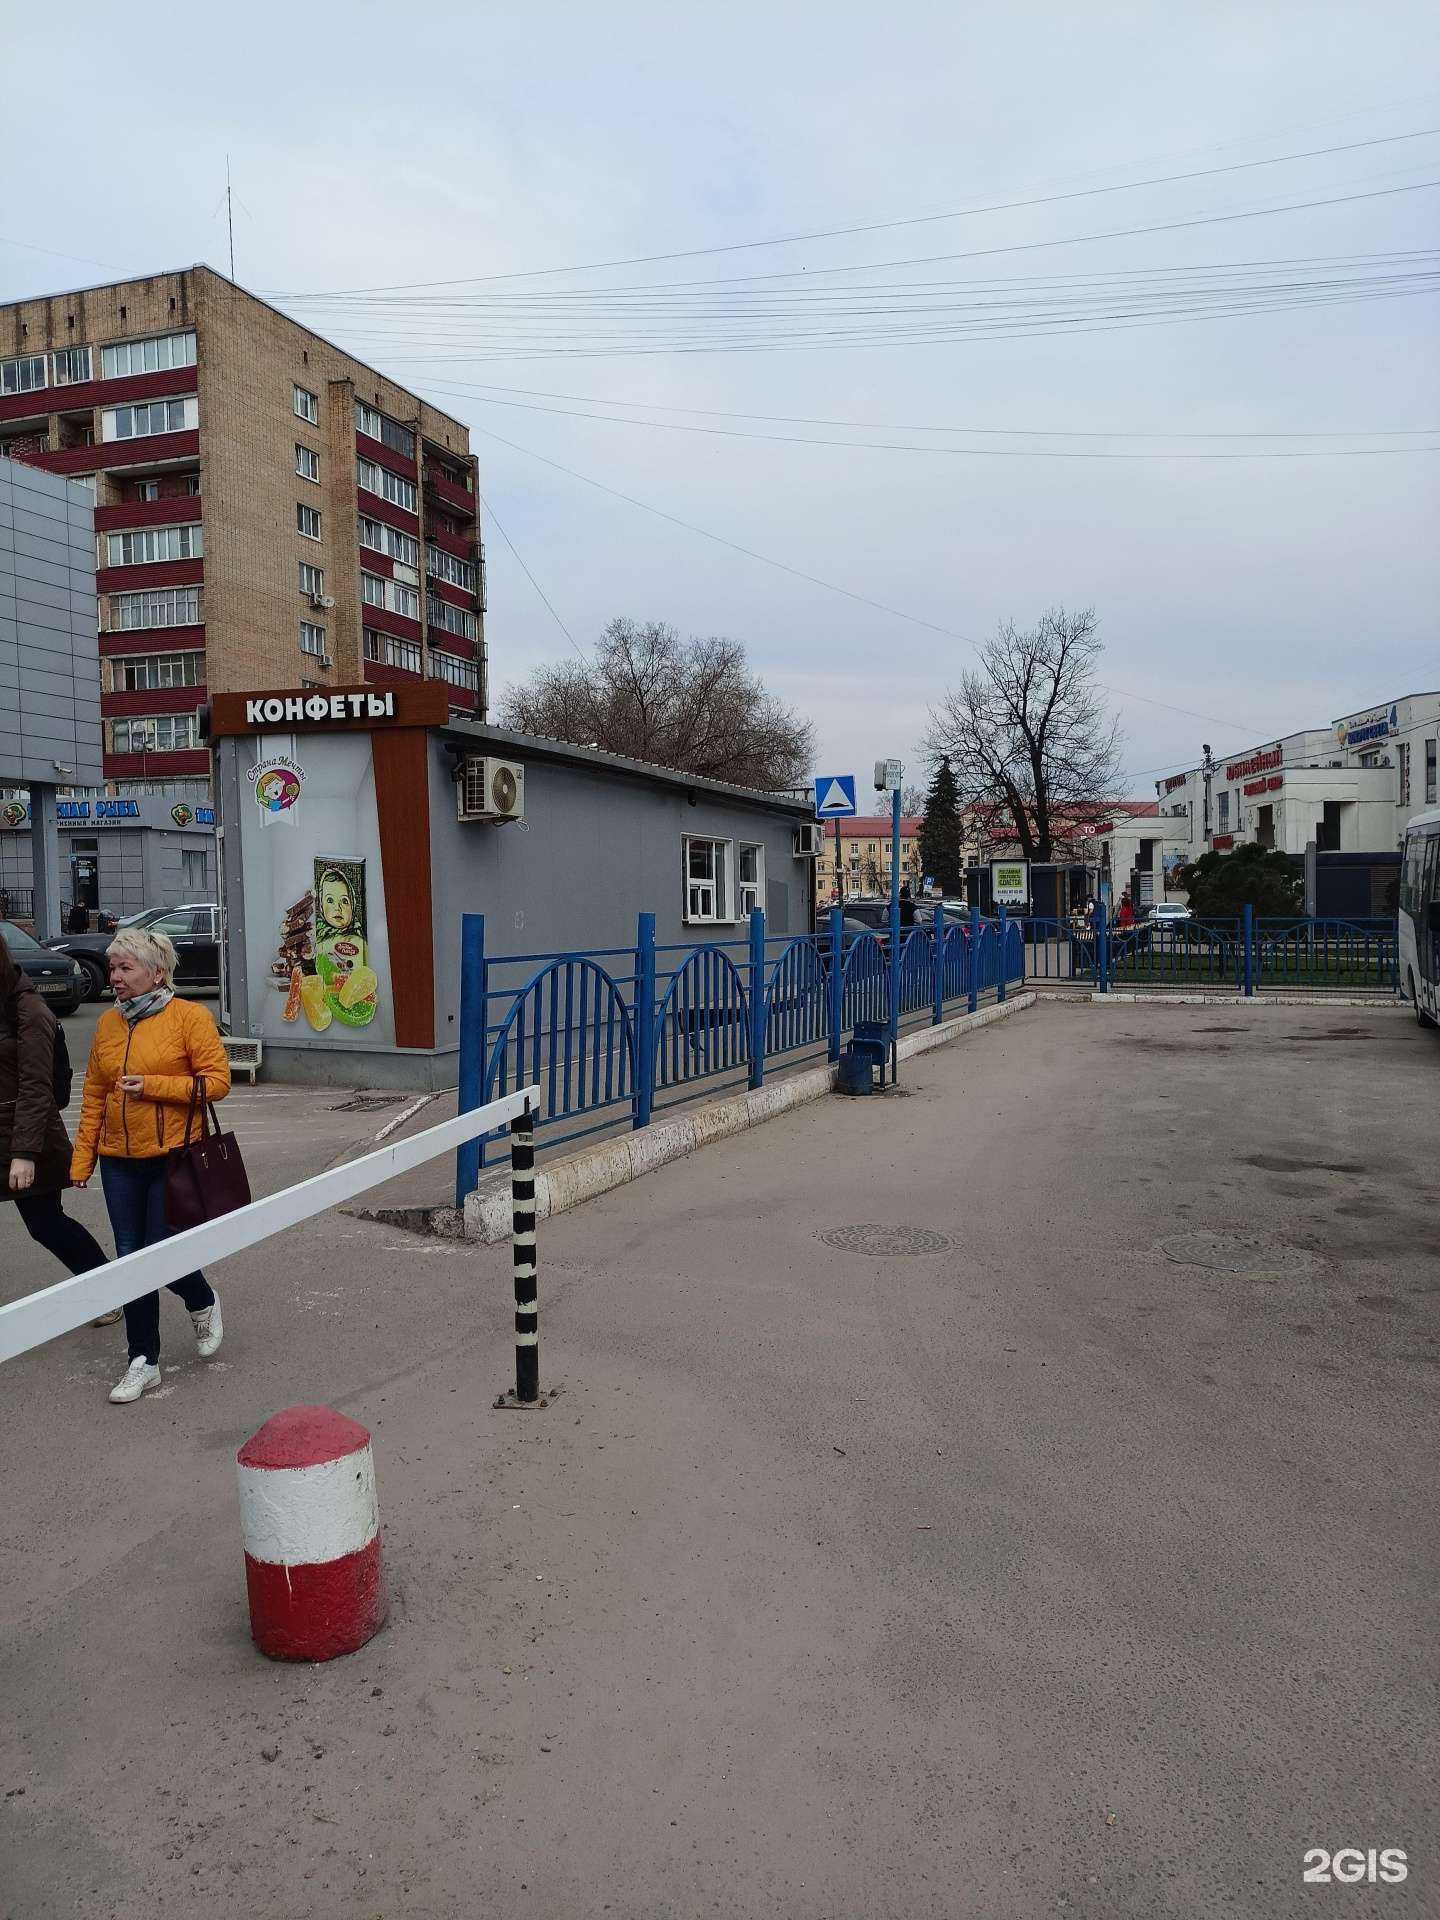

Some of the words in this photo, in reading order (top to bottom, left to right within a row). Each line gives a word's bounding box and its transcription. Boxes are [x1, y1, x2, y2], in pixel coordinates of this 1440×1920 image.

[246, 692, 394, 723] КОНФЕТЫ
[247, 758, 277, 781] Страна
[278, 756, 306, 781] Мечты
[95, 800, 140, 819] РЫБА
